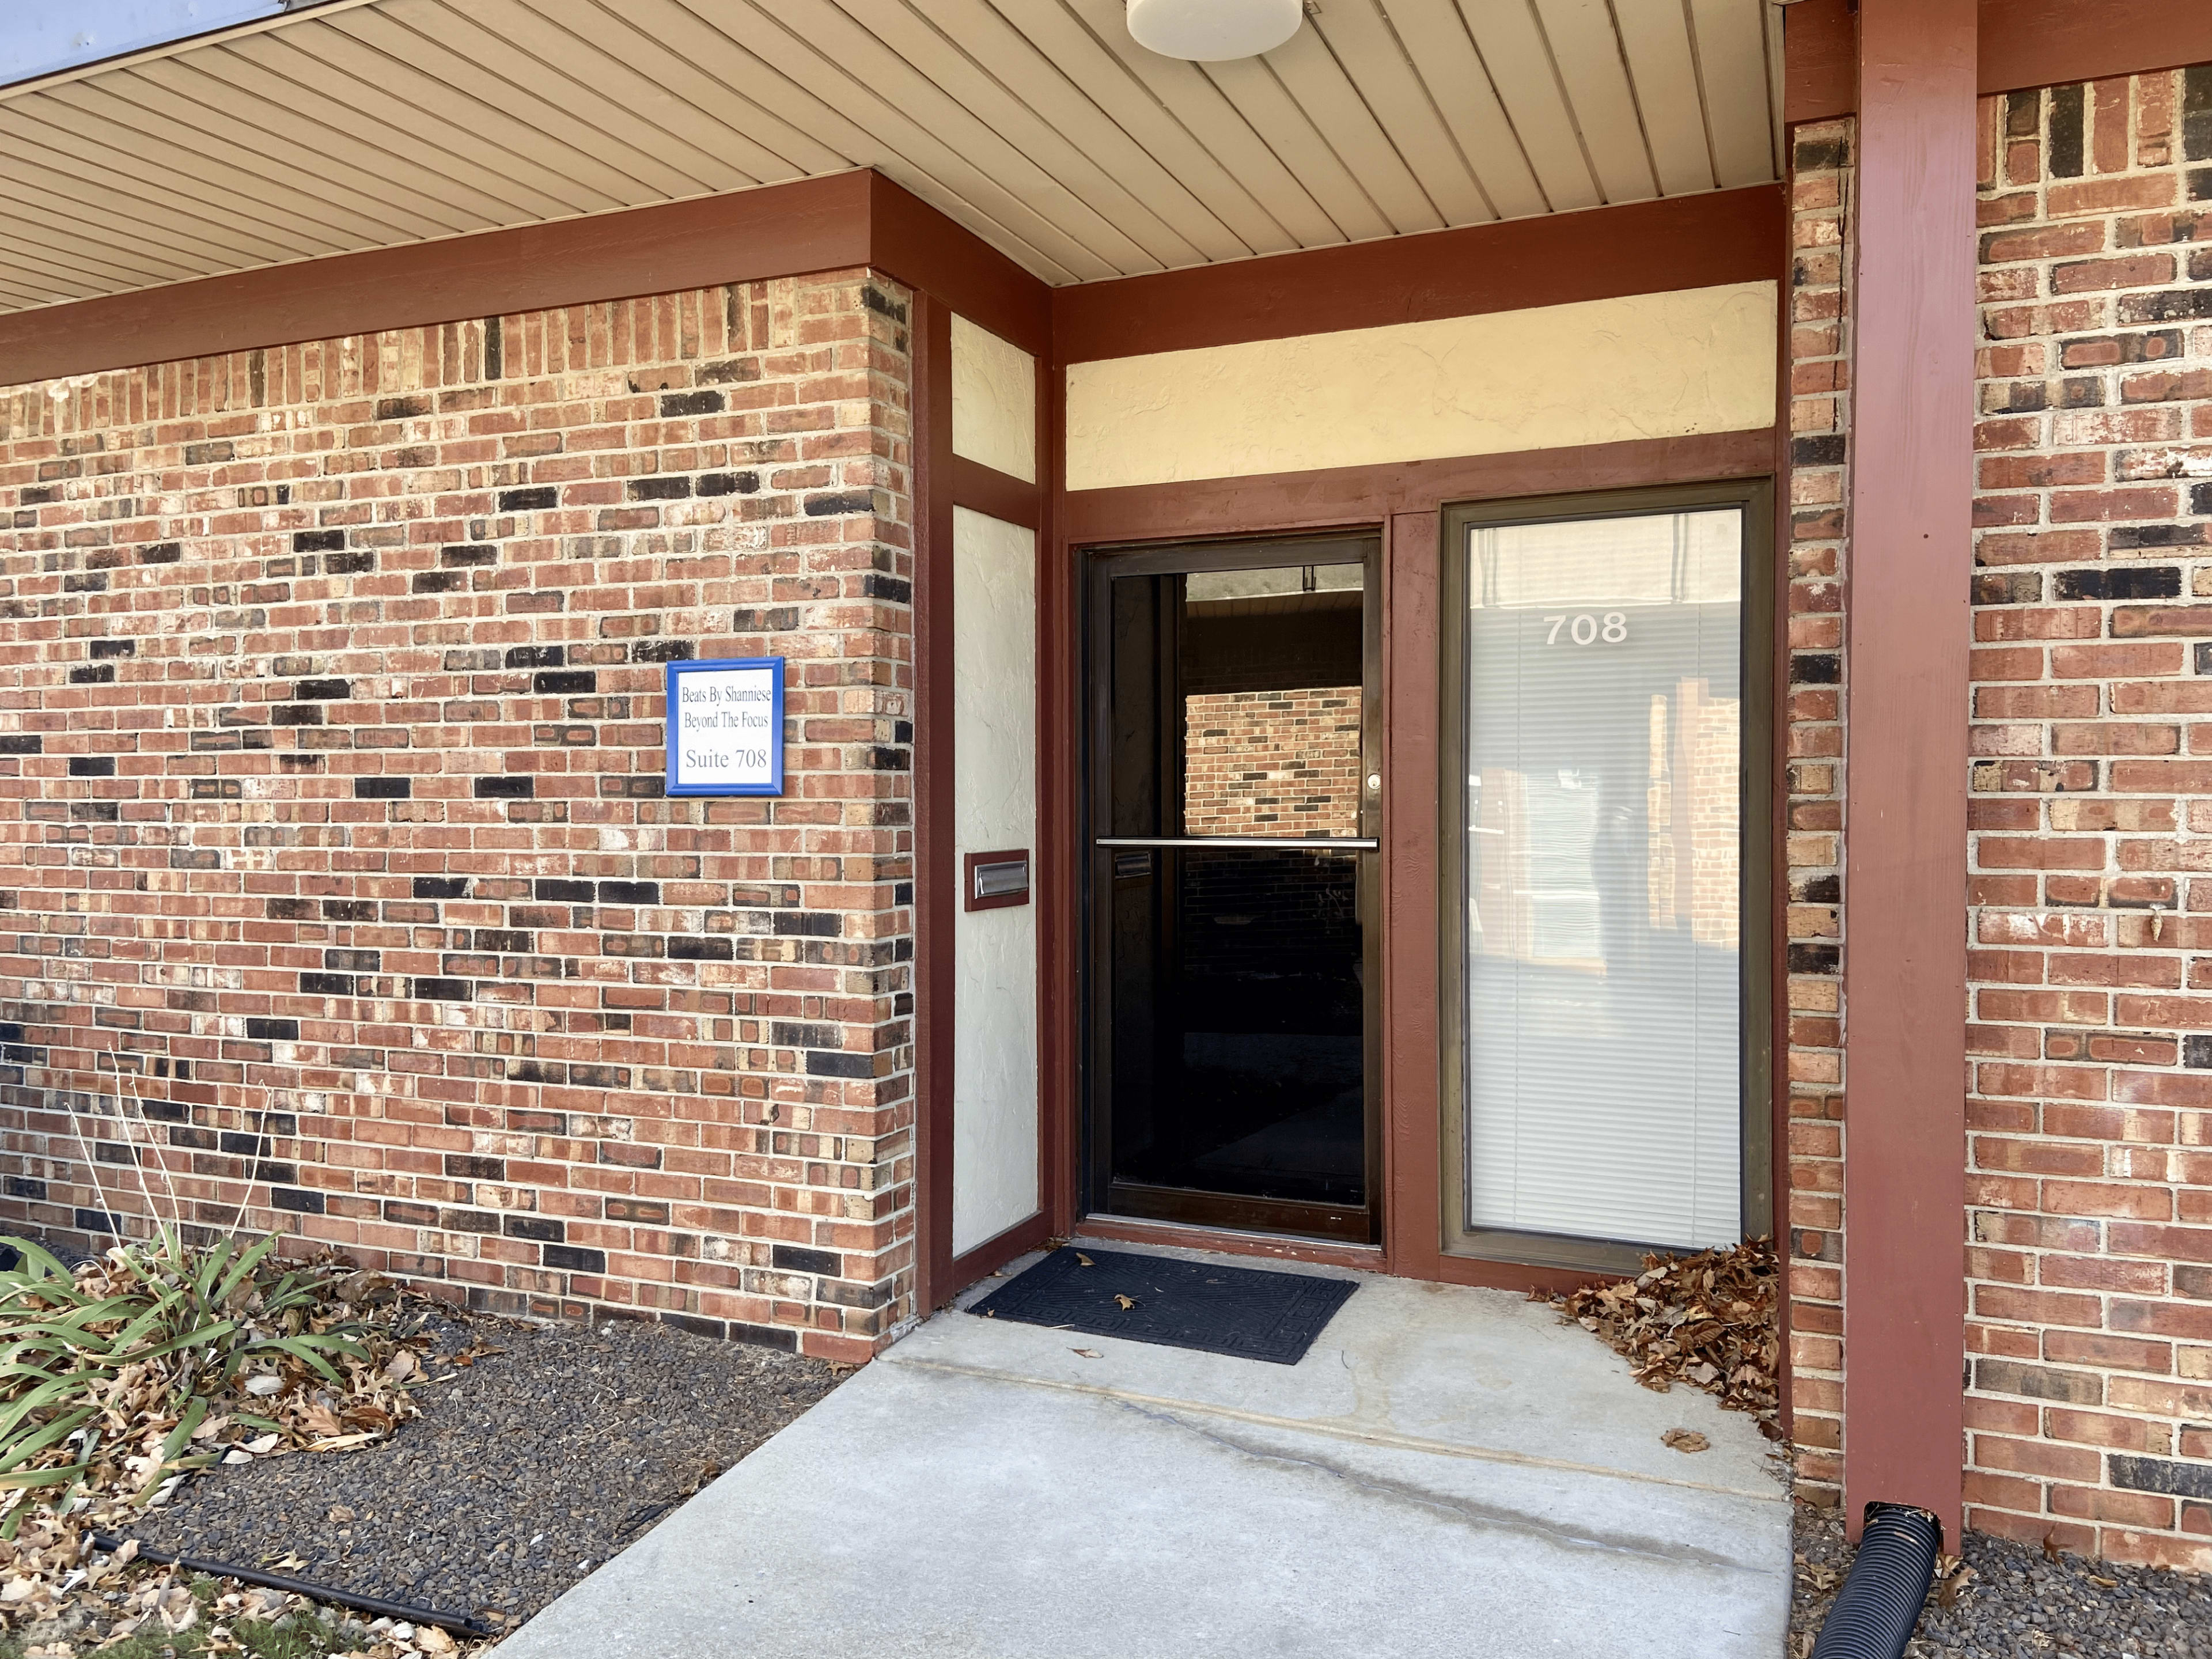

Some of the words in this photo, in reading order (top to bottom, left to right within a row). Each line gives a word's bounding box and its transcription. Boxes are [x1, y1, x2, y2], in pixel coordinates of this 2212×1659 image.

[1543, 611, 1627, 645] 708
[682, 686, 706, 702] Beats
[709, 686, 722, 706] By
[725, 684, 771, 702] Shanniese
[684, 711, 718, 732] Beyond
[721, 711, 738, 728] The
[742, 711, 768, 727] Focus
[686, 749, 729, 768] Suite
[736, 749, 766, 768] 708
